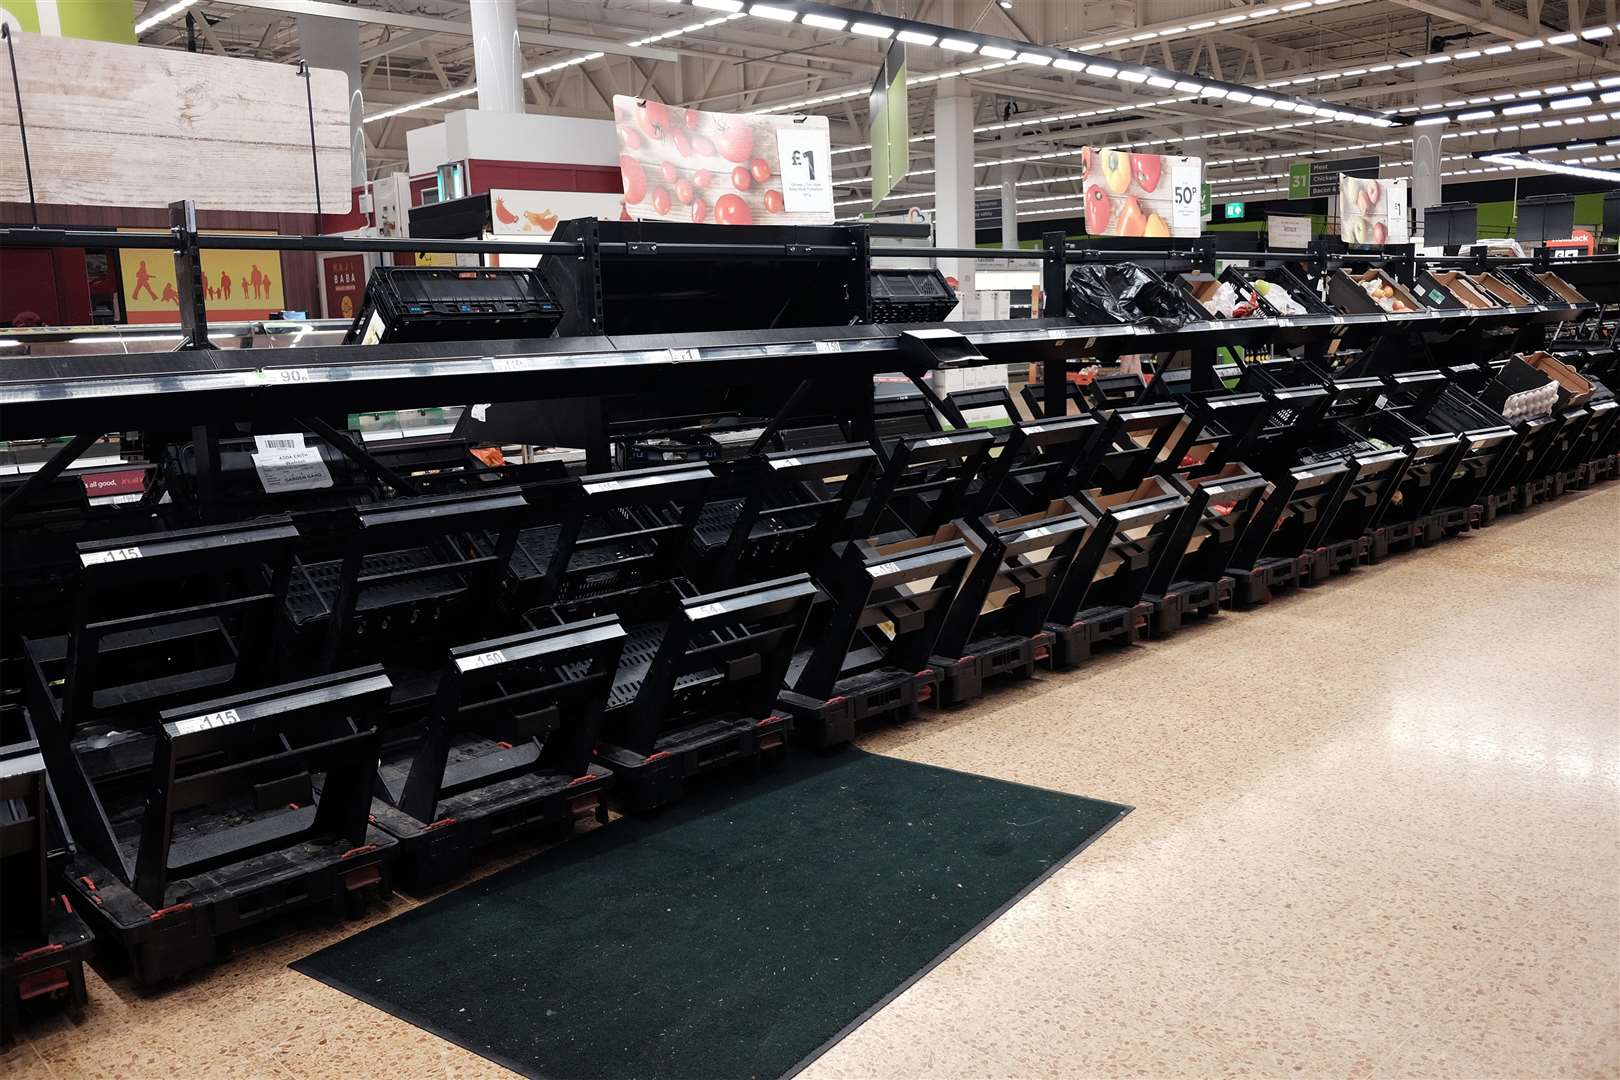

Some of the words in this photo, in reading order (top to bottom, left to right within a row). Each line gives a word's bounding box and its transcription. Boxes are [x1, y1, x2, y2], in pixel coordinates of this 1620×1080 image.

[792, 150, 815, 180] £1
[1292, 175, 1306, 188] 31
[334, 273, 355, 284] BABA
[97, 480, 117, 488] good,
